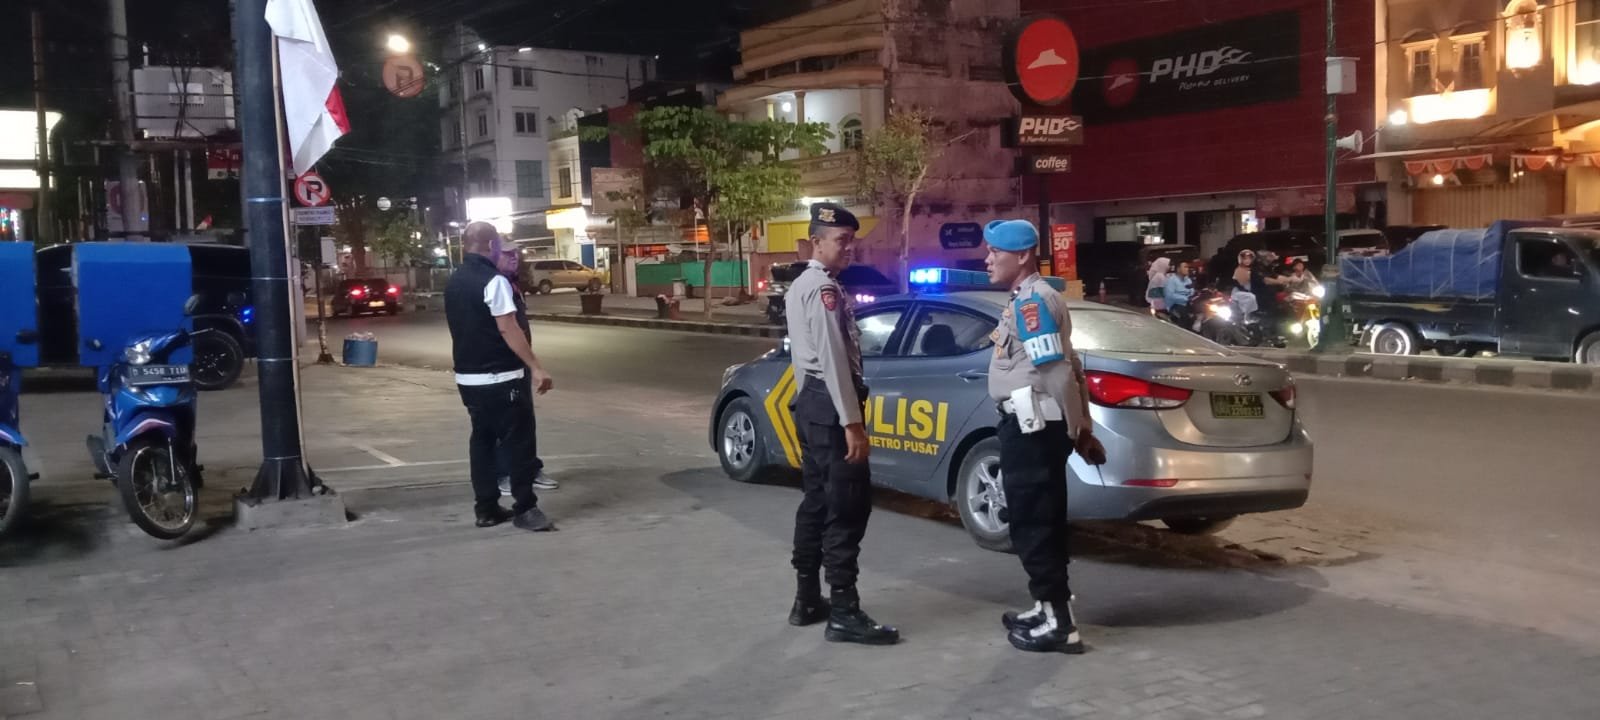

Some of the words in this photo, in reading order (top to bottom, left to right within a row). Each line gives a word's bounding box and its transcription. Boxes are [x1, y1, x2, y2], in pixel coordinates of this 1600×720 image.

[1149, 49, 1226, 83] PHD
[1019, 117, 1066, 135] PHD
[1035, 156, 1068, 169] coffee
[864, 394, 949, 442] LISI
[903, 440, 940, 455] PUSAT
